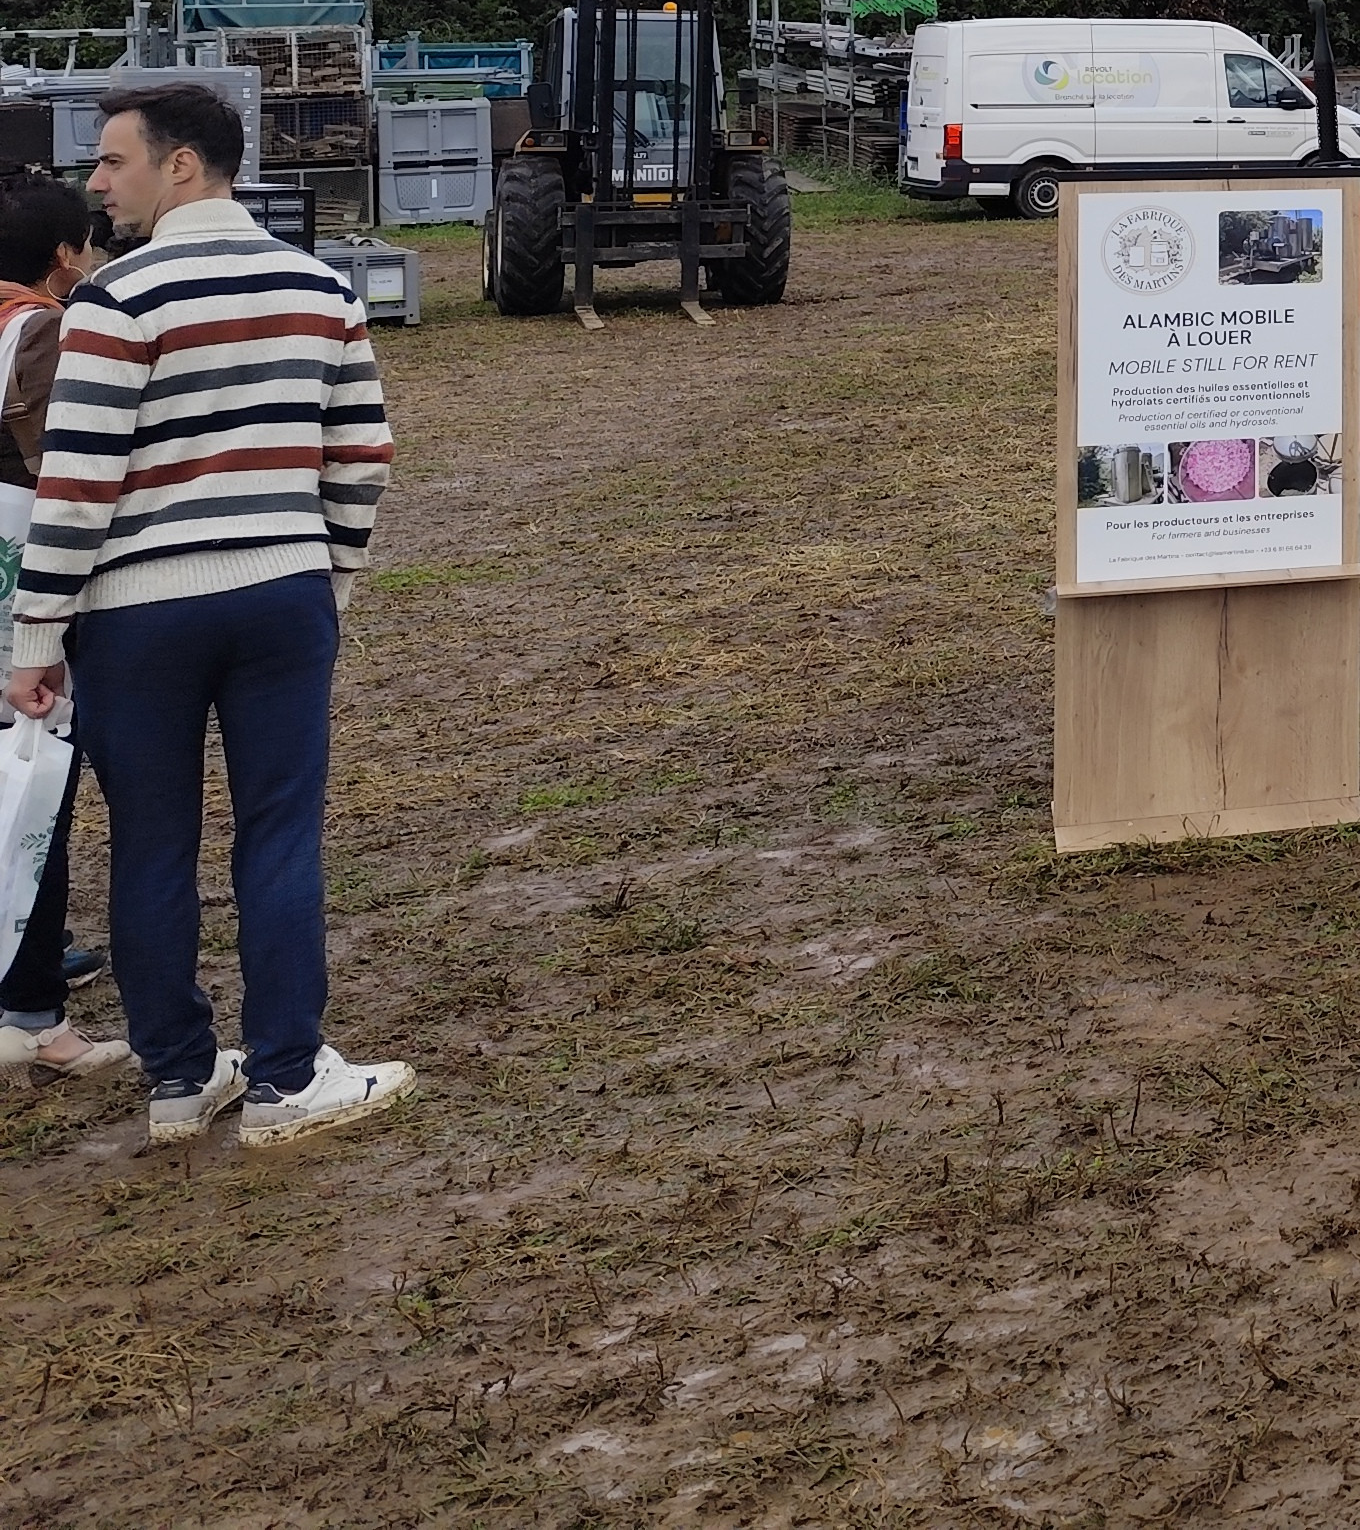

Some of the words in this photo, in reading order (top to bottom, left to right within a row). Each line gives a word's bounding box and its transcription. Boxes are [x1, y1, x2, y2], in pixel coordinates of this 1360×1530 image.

[1077, 69, 1153, 85] location
[1111, 222, 1128, 237] LA
[1126, 210, 1186, 236] FABRIQUE
[1112, 264, 1134, 285] DES
[1133, 258, 1184, 290] MARTINS
[1122, 312, 1215, 329] ALAMBIC
[1220, 308, 1295, 326] MOBILE
[1167, 328, 1181, 347] À
[1187, 329, 1252, 347] LOUER
[1108, 358, 1177, 375] MOBILE
[1181, 357, 1227, 372] STILL
[1232, 355, 1269, 370] FOR
[1273, 353, 1319, 369] RENT
[1113, 386, 1173, 397] Production
[1176, 384, 1196, 394] des
[1232, 381, 1295, 392] essentielles
[1297, 380, 1309, 389] et
[1111, 397, 1164, 409] hydrolats
[1213, 393, 1227, 403] ou
[1229, 390, 1311, 402] conventionnels
[1119, 412, 1172, 423] Production
[1174, 410, 1186, 420] of
[1187, 409, 1228, 419] certified
[1230, 409, 1241, 418] or
[1242, 406, 1304, 417] conventional
[1144, 421, 1188, 432] essential
[1190, 420, 1206, 429] oils
[1208, 419, 1228, 429] and
[1106, 521, 1131, 530] Pour
[1133, 519, 1149, 529] les
[1152, 517, 1220, 529] producteurs
[1222, 515, 1234, 524] et
[1236, 513, 1251, 523] les
[1253, 510, 1315, 521] entreprises
[1151, 532, 1166, 540] For
[1168, 530, 1202, 540] farmers
[1204, 529, 1221, 538] and
[1222, 527, 1271, 537] businesses
